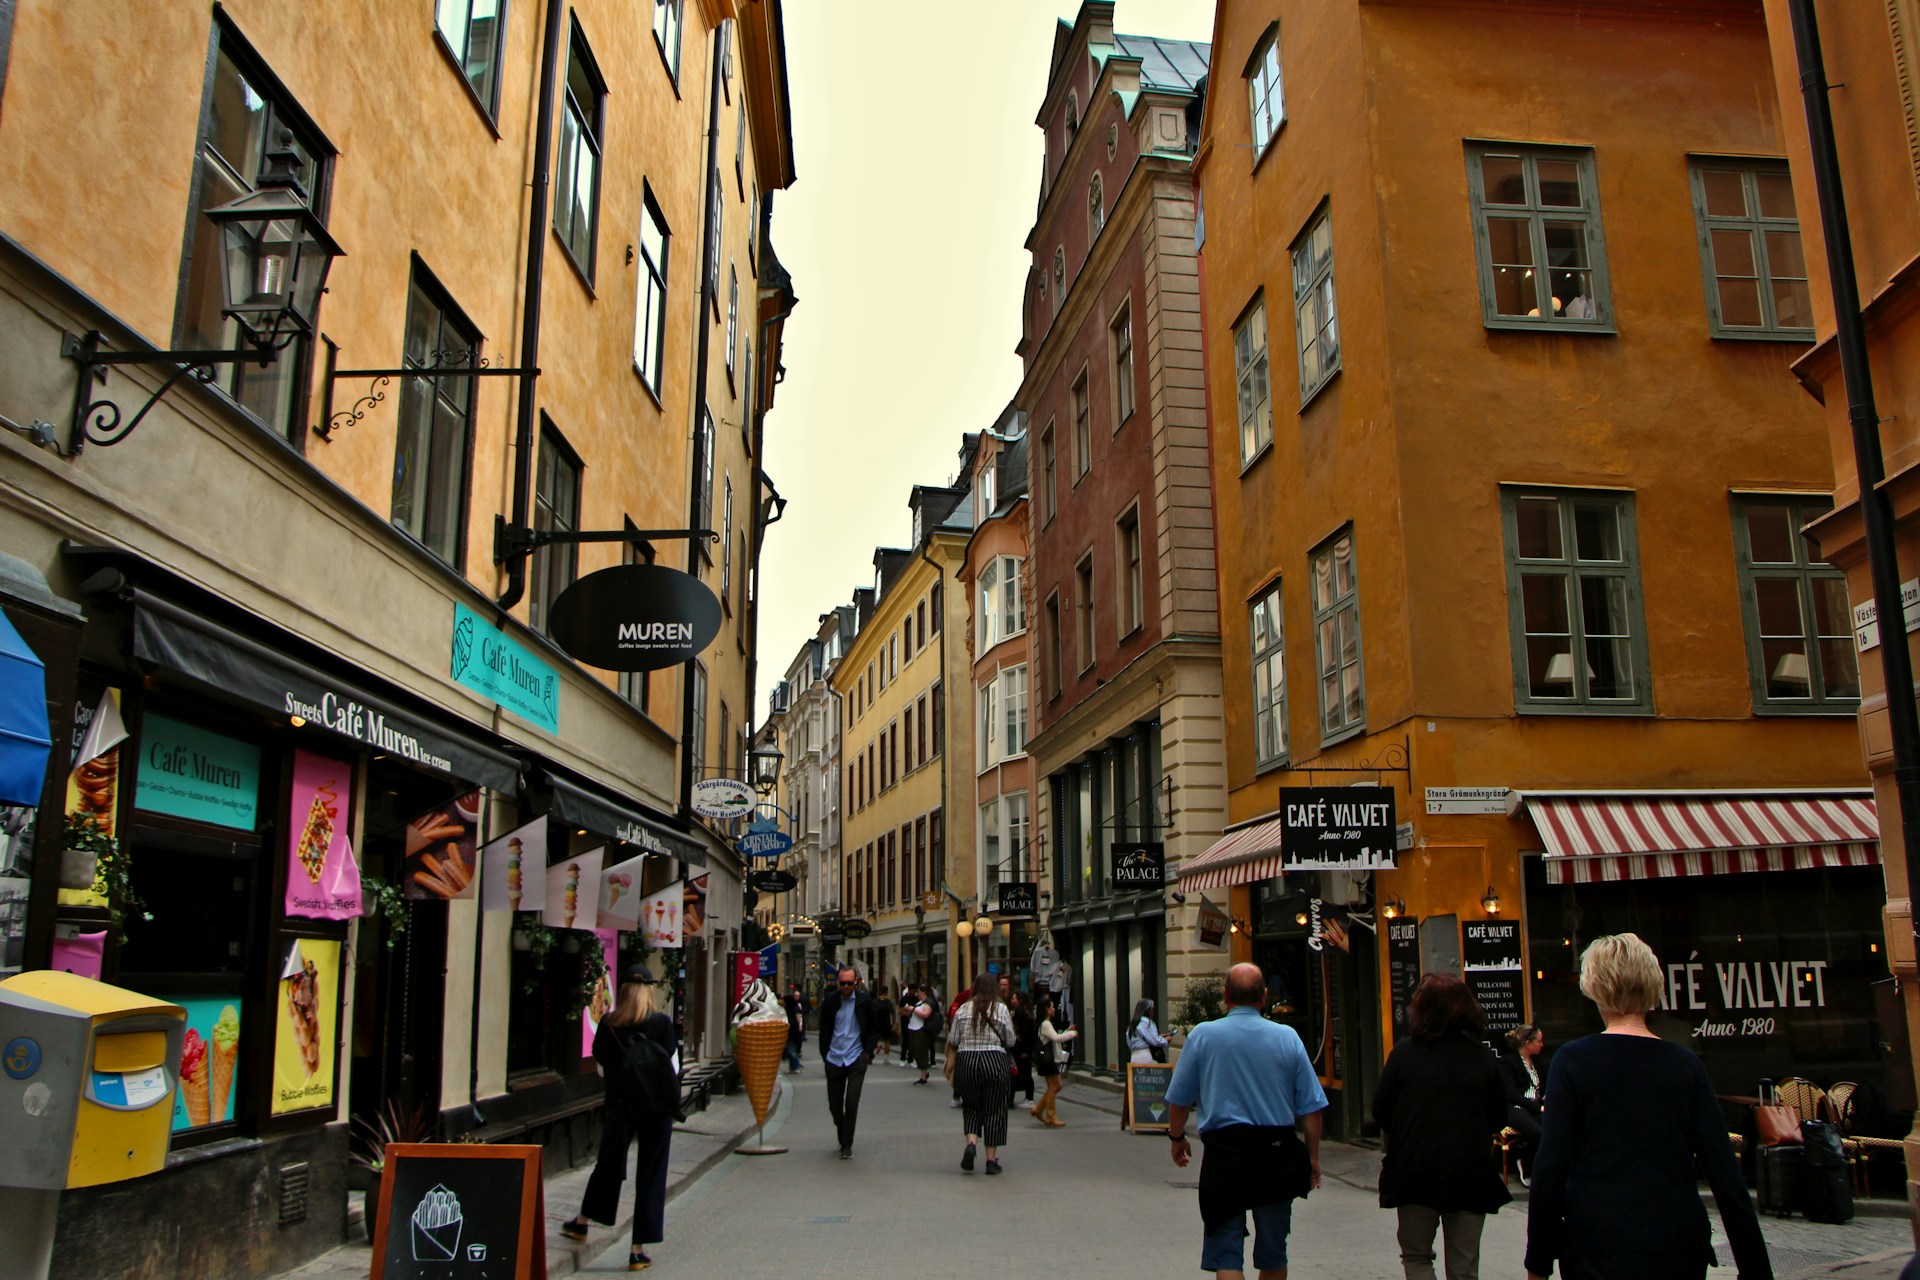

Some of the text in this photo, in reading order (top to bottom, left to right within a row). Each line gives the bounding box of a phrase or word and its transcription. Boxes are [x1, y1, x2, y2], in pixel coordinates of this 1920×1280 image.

[618, 622, 693, 640] MUREN
[1859, 632, 1868, 646] 16
[482, 637, 507, 676] Café
[509, 653, 540, 698] Muren
[285, 691, 322, 724] Sweets
[321, 691, 364, 739] Café
[367, 709, 419, 760] Muren
[150, 742, 241, 790] Café Muren
[697, 779, 748, 794] Skärgårdskatten
[1427, 788, 1506, 799] Stora Gråmunkegränd
[1287, 797, 1389, 827] CAFÉ VALVET
[743, 833, 778, 850] KRISTALL
[1318, 830, 1361, 840] Anno 1980
[752, 841, 787, 854] RUMMET
[1116, 867, 1160, 880] PALACE
[1002, 900, 1034, 909] PALACE
[1308, 898, 1323, 951] Churros
[1468, 924, 1513, 938] CAFÉ VALVET
[1715, 960, 1827, 1009] VALVET
[1480, 1002, 1497, 1010] NJOY
[1691, 1017, 1775, 1037] Anno 1980
